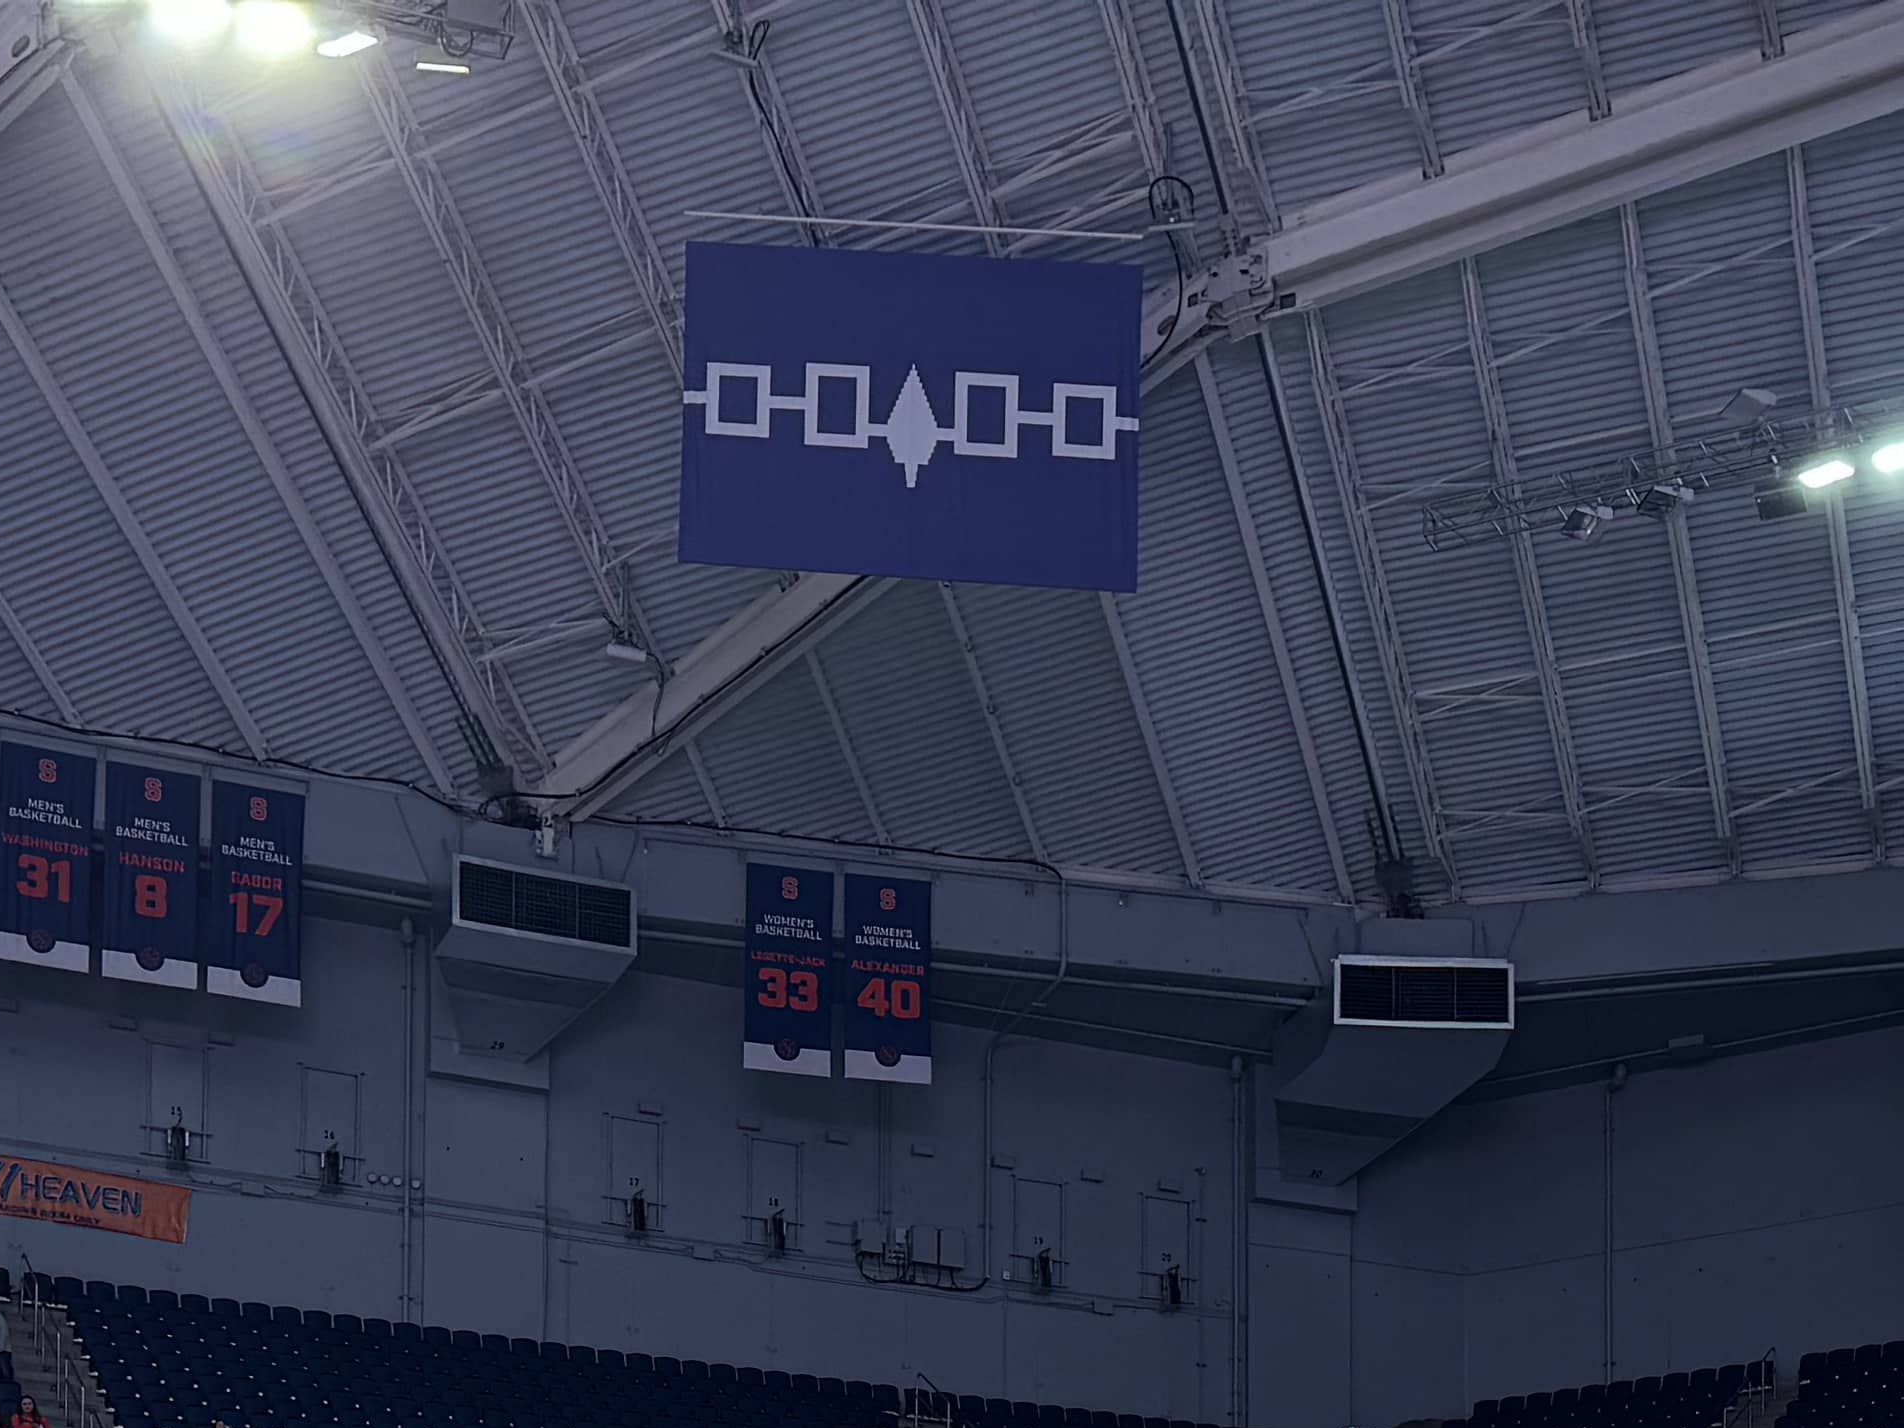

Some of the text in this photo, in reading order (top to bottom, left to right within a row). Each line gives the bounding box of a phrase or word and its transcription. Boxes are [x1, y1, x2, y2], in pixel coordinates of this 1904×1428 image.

[8, 806, 83, 830] BASKETBALL
[1, 831, 89, 857] WASHINGTON
[16, 853, 72, 904] 31
[119, 851, 186, 874] HANSON
[134, 874, 167, 919] 8
[228, 891, 284, 937] 17
[763, 913, 815, 929] WOMEN'S
[862, 925, 913, 938] WOMEN'S
[851, 959, 925, 976] ALEXANDER
[757, 967, 819, 1012] 33
[857, 977, 921, 1019] 40
[20, 1171, 143, 1218] HEAVEN
